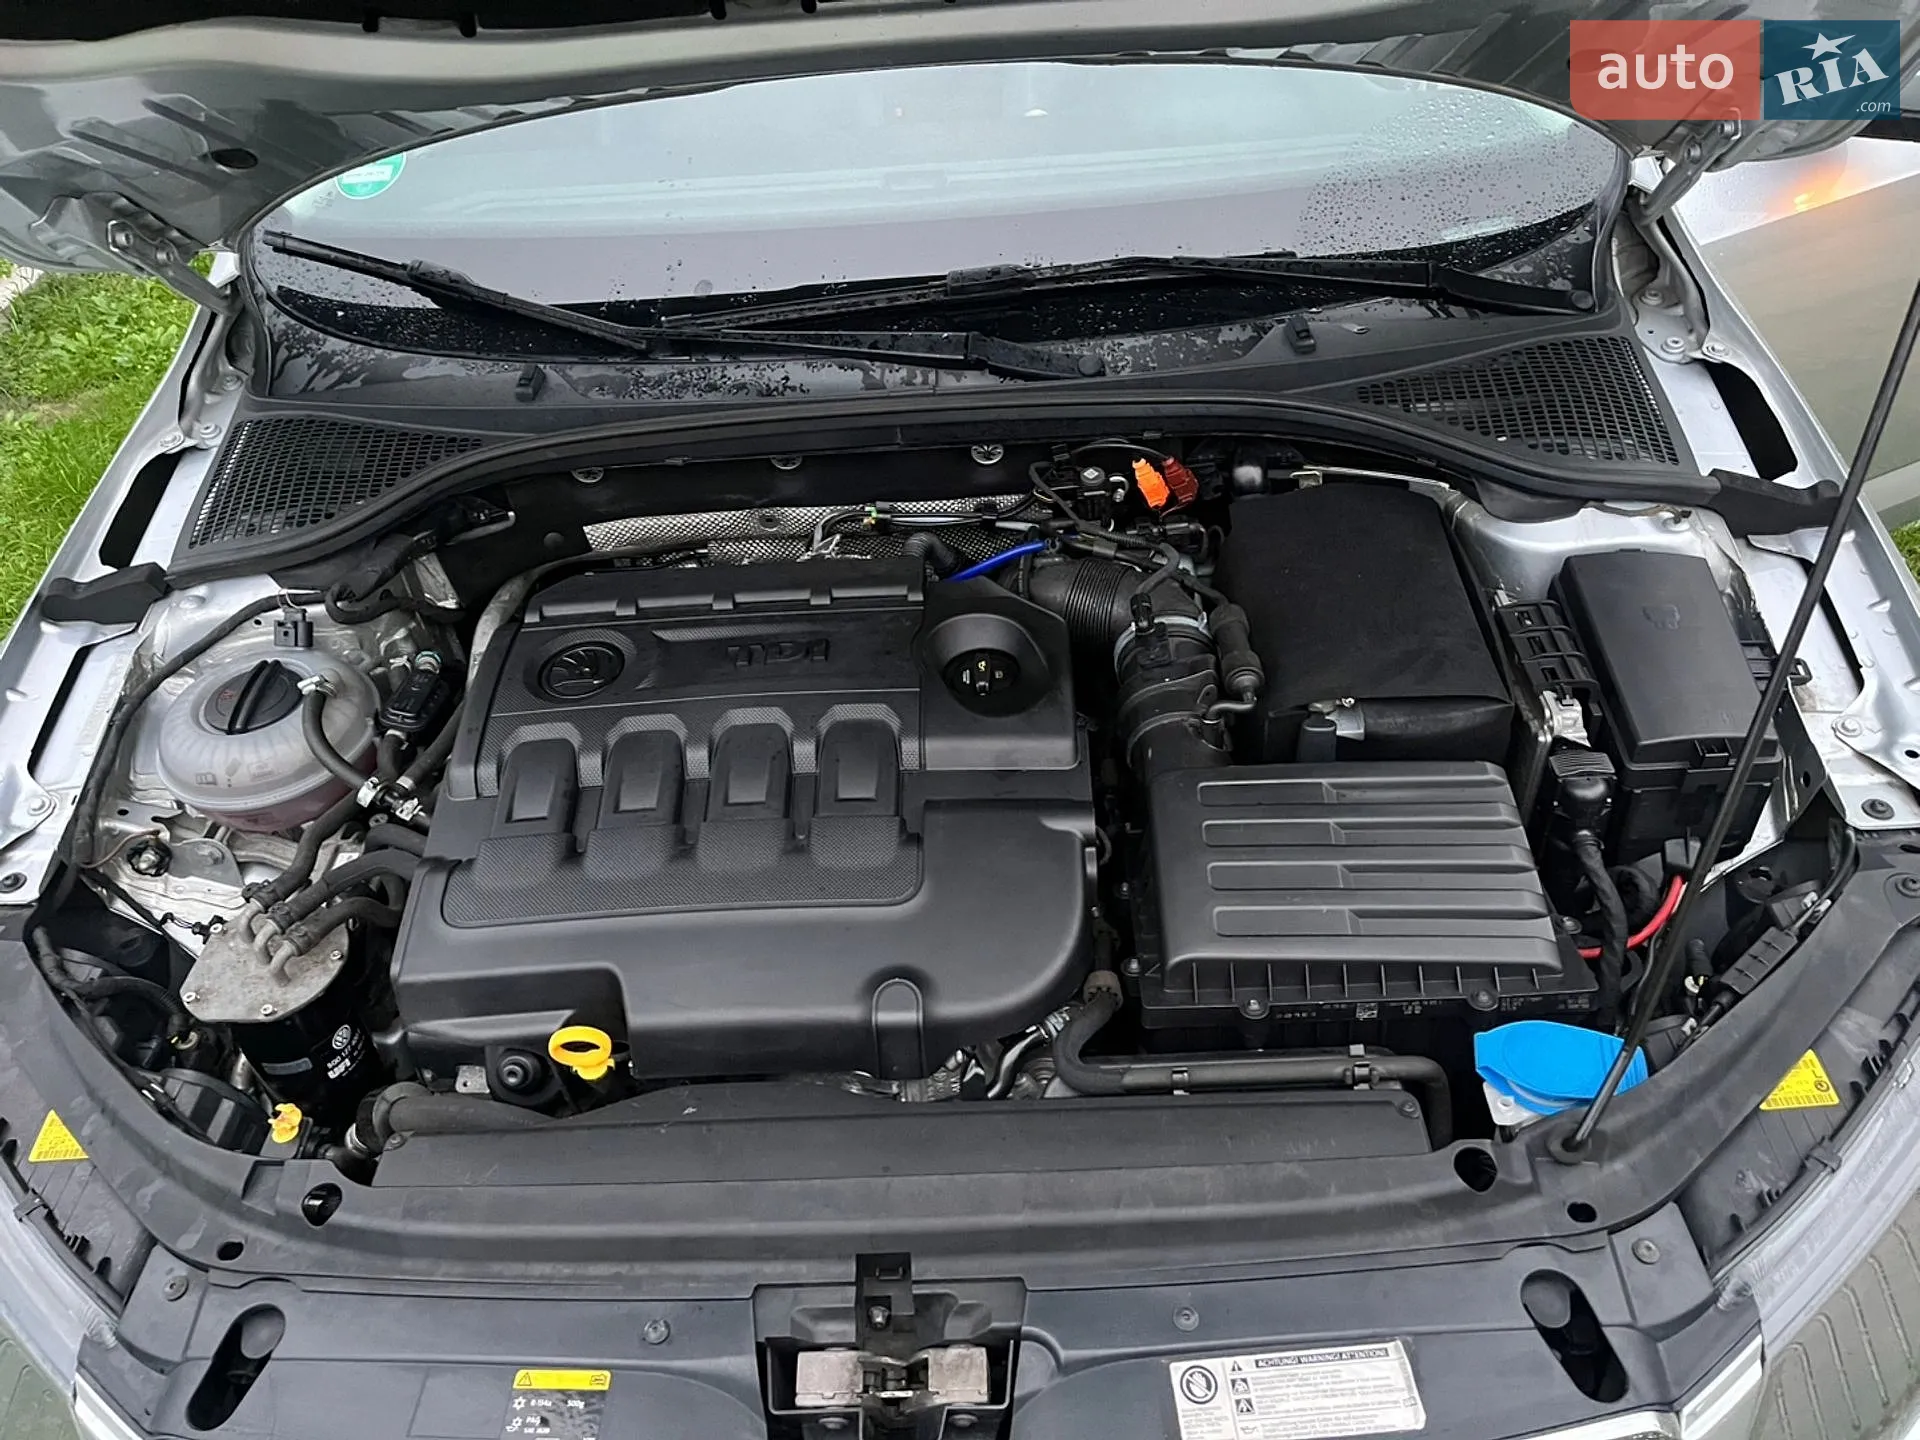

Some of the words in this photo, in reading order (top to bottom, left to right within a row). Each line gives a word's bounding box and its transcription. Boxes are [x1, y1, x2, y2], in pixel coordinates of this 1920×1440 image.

[726, 637, 831, 667] TDI
[1256, 1355, 1300, 1369] ACHTUNG!
[1300, 1352, 1341, 1365] WARNING!
